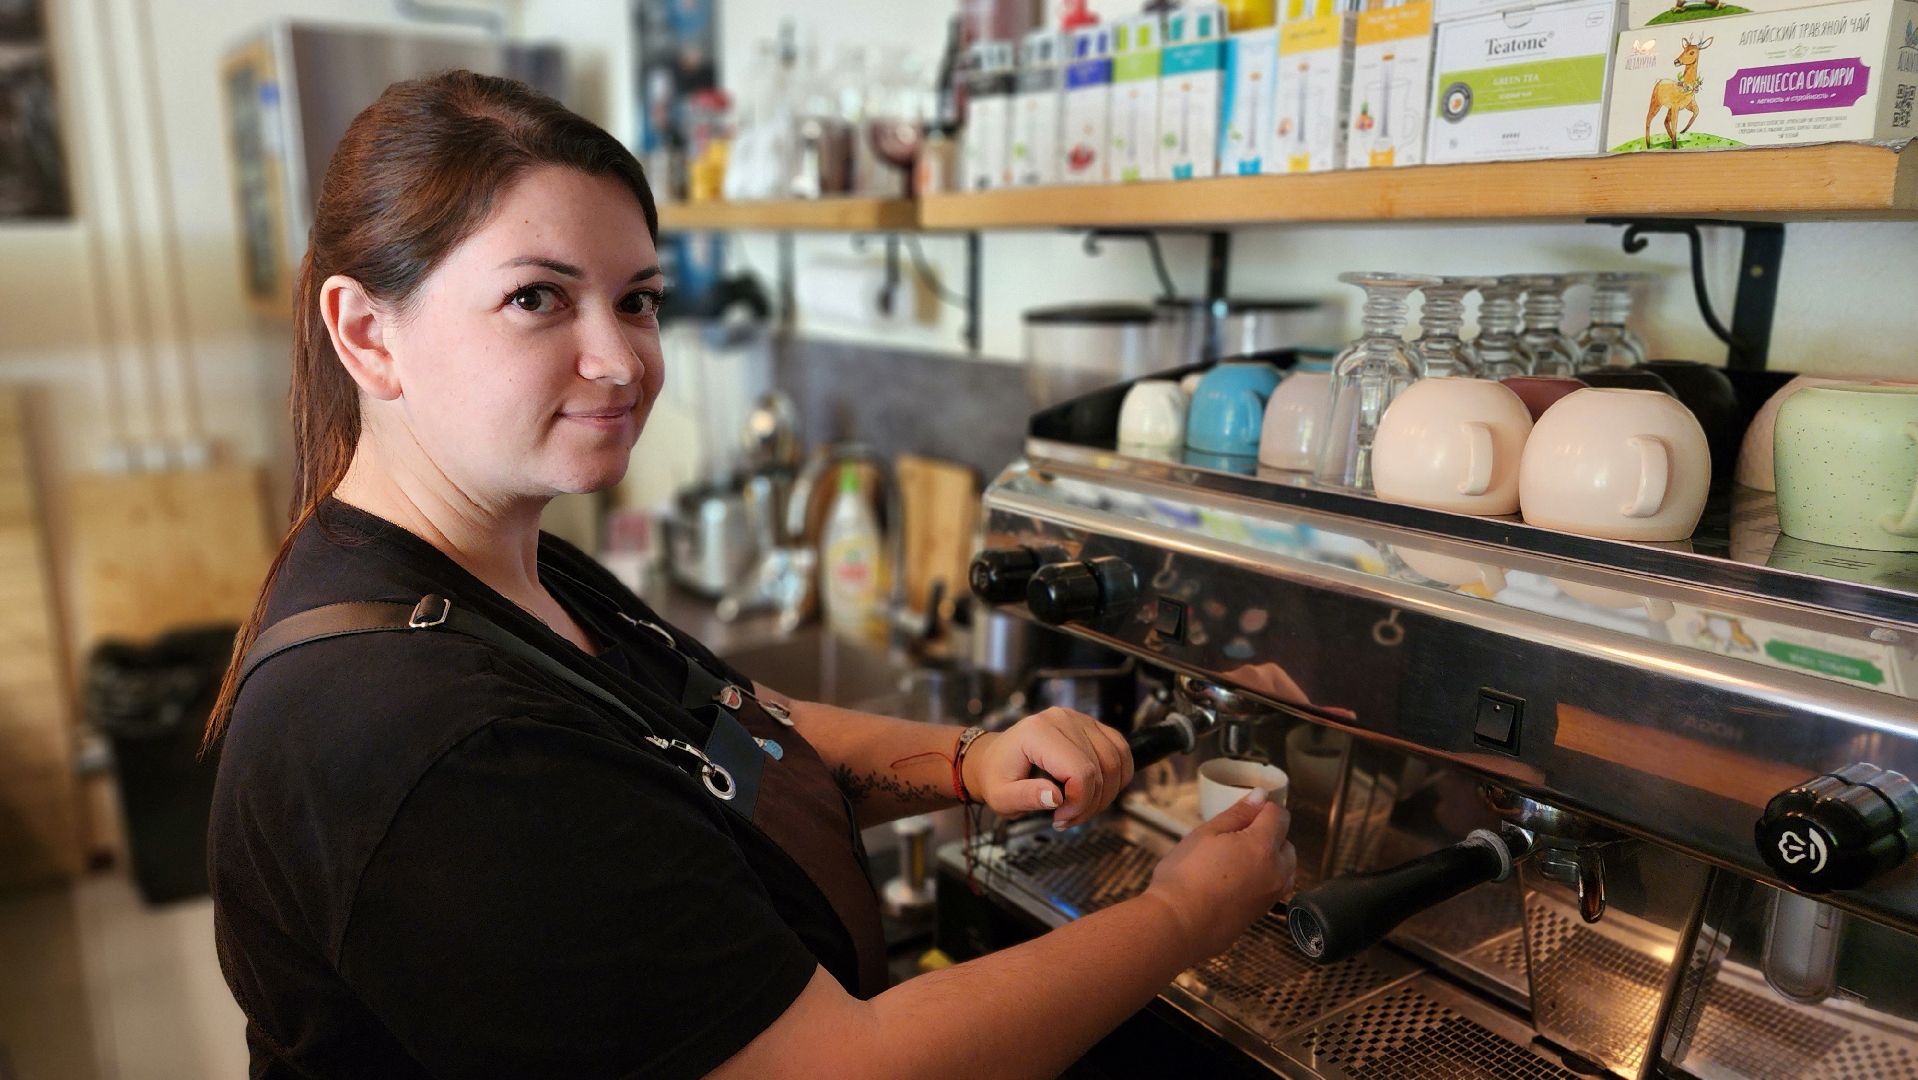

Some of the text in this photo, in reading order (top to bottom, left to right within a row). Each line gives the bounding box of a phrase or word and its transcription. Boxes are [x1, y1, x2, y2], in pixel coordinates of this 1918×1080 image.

[1739, 12, 1870, 45] АЛТАЙСКИЙ ТРАВЯНОЙ ЧАЙ
[1485, 37, 1547, 55] Teatone
[1493, 73, 1539, 86] GREEN TEA
[1739, 67, 1855, 94] ПРИНЦЕССА СИБИРИ
